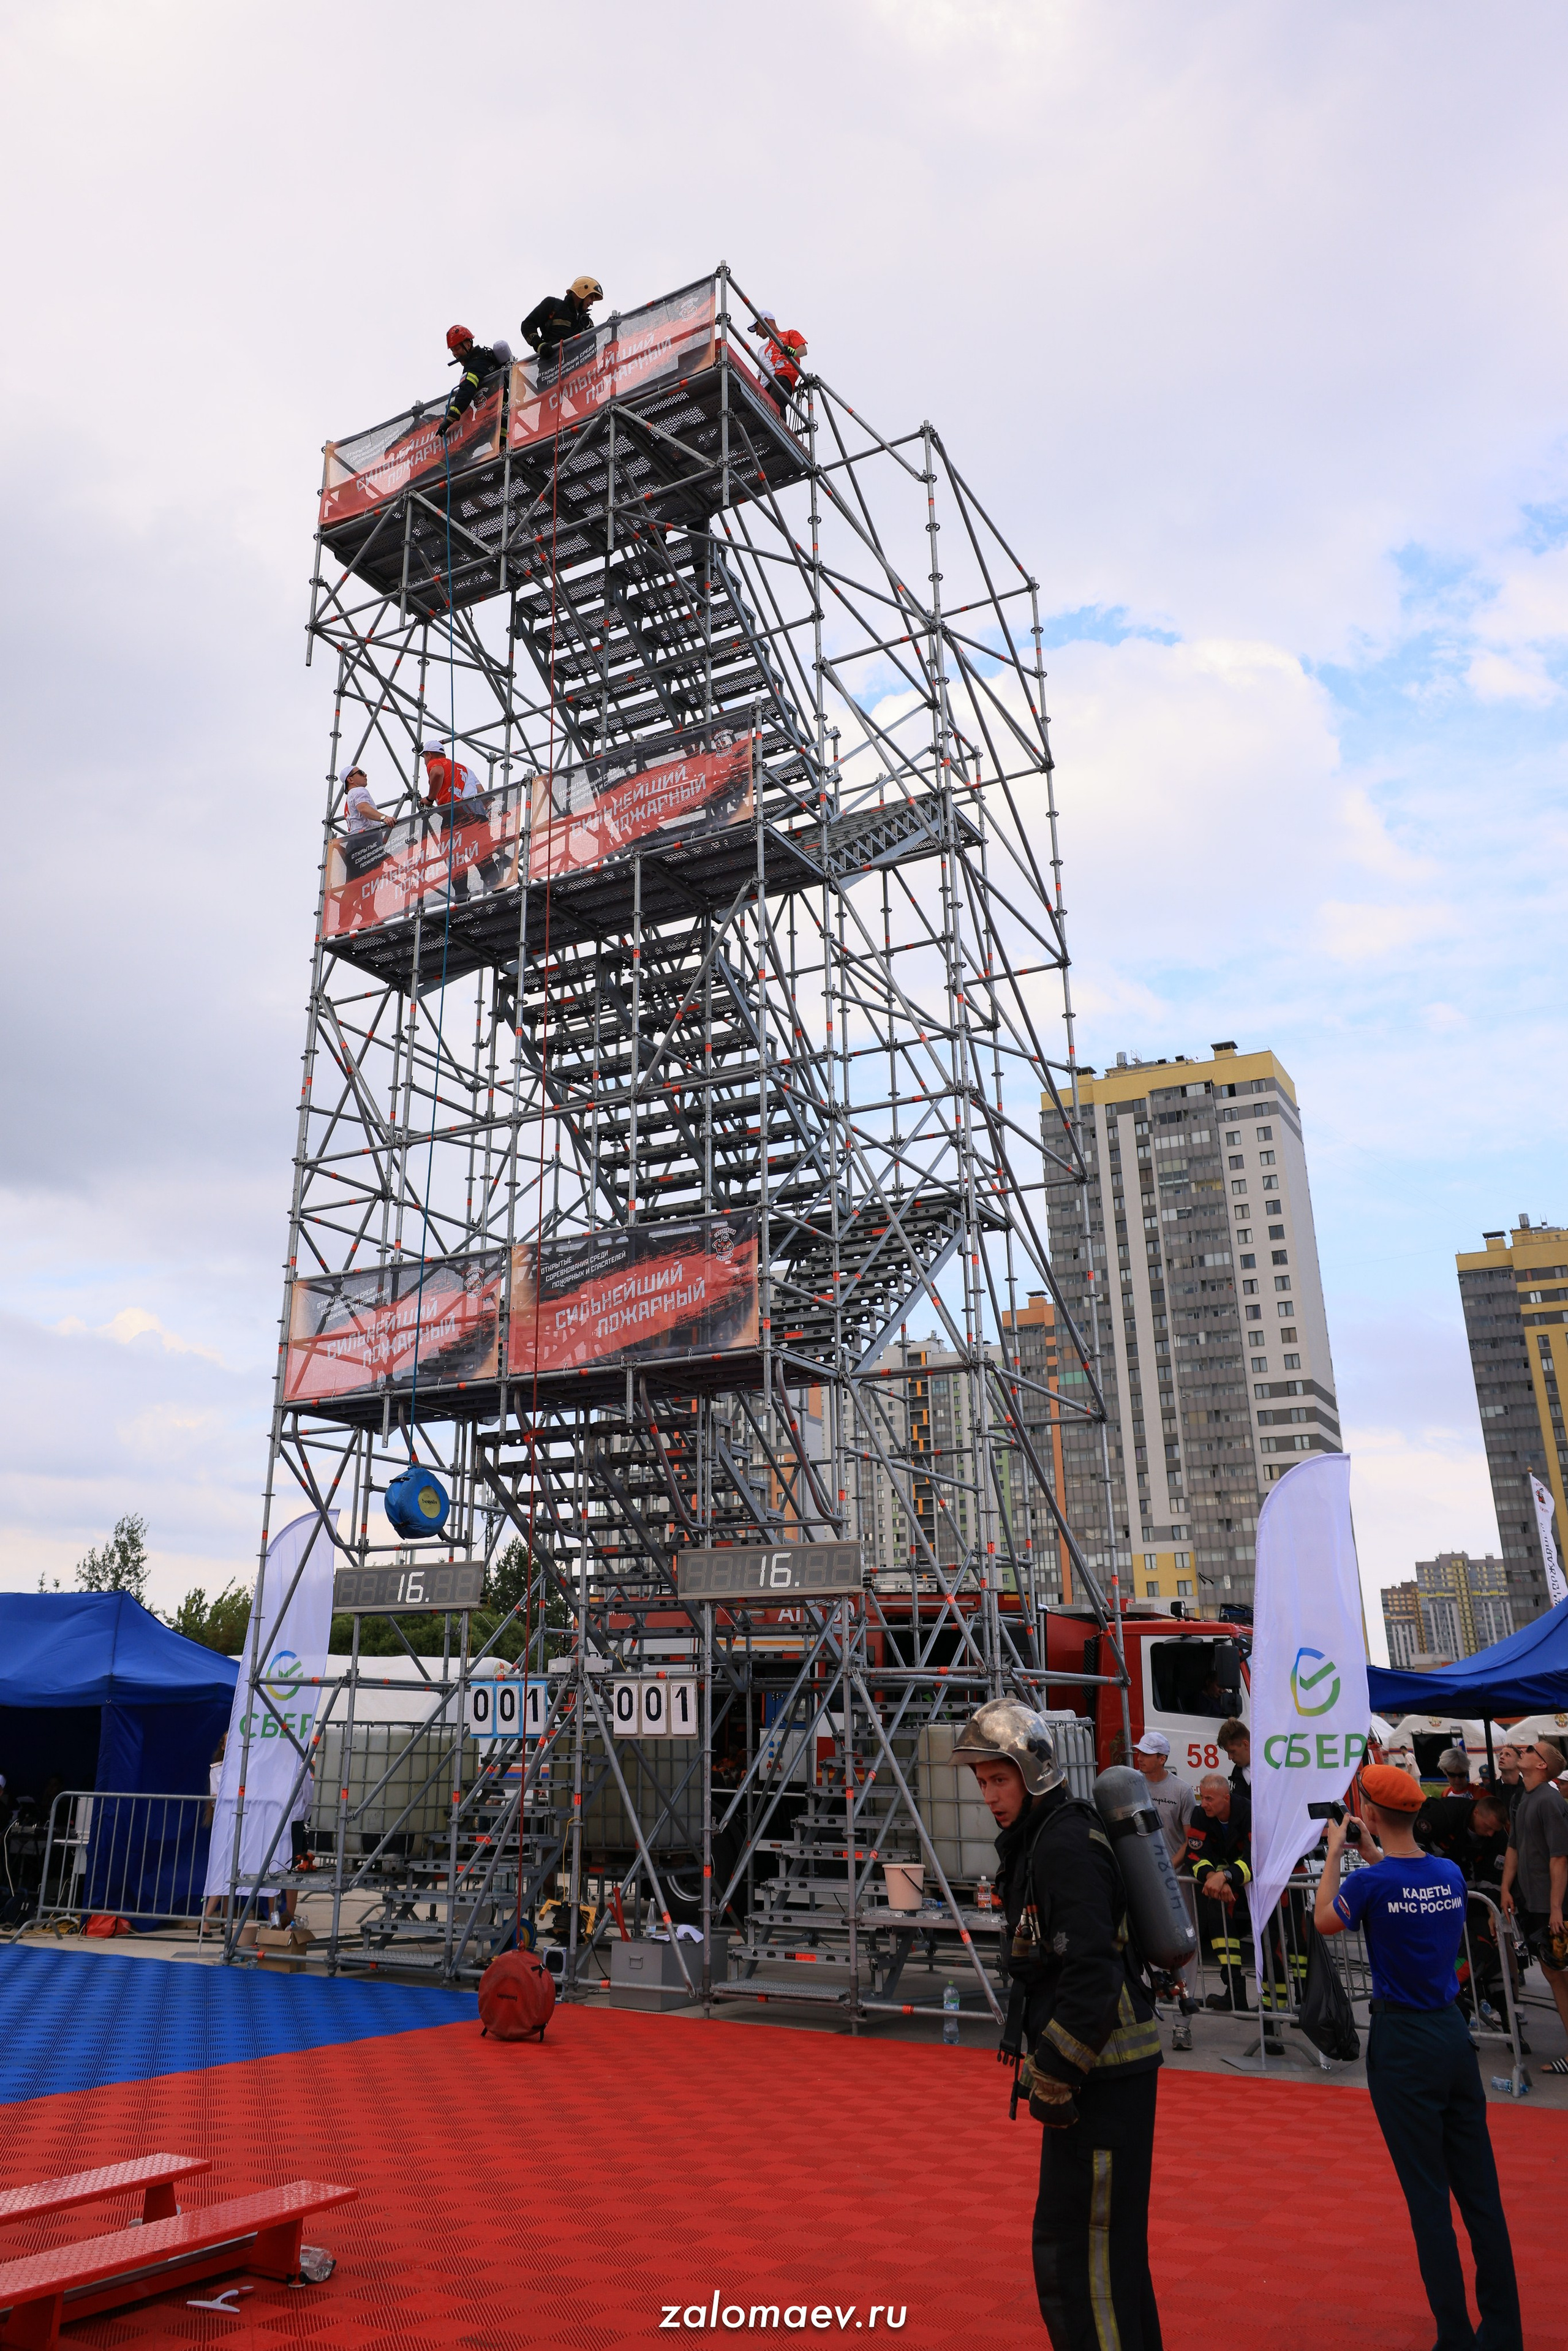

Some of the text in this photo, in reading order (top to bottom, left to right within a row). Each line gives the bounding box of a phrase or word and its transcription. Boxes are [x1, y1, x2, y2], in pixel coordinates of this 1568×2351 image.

[538, 359, 565, 377] ОТКРЫТЕ
[541, 343, 595, 381] СОРЕВОВАНИЯ СРЕДИ
[559, 777, 587, 798] ОТКРЫТЫЕ
[603, 766, 620, 781] СРЕДИ
[571, 764, 687, 838] СИЛЬНЕЙШИЙ
[610, 772, 706, 839] ПОЖАРНЫЙ
[351, 841, 378, 860] ОТКРЫТЫЕ
[360, 850, 386, 869] ПОЖАРНЫХ
[361, 831, 462, 900] СИЛЬНЕЙШИЙ
[541, 1256, 573, 1275] ОТКРЫТЫЕ
[546, 1250, 609, 1282] СОРЕВНОВАНИЯ СРЕДИ
[552, 1270, 585, 1289] ПОЖАРНЫХ
[590, 1250, 626, 1274] СПАСАТЕЛЕЙ
[317, 1292, 345, 1309] ОТКРЫТЫЕ
[321, 1286, 376, 1316] СОРЕВНОВАНИЯ СРЕДИ
[325, 1305, 355, 1323] ПОЖАРНЫХ
[360, 1286, 390, 1308] СПАСАТЕЛЕЙ
[556, 1261, 683, 1330] СИЛЬНЕЙШИЙ
[598, 1277, 706, 1338] ПОЖАРНЫЙ
[327, 1297, 439, 1361] СИЛЬНЕЙШИЙ
[363, 1311, 456, 1368] ПОЖАРНЫЙ
[473, 1688, 539, 1723] 001
[617, 1686, 688, 1722] 001
[1187, 1744, 1219, 1769] 58
[1264, 1733, 1368, 1770] СБЕР
[1387, 1896, 1463, 1914] МЧС РОССИИ
[1402, 1884, 1452, 1901] КАДЕТЫ
